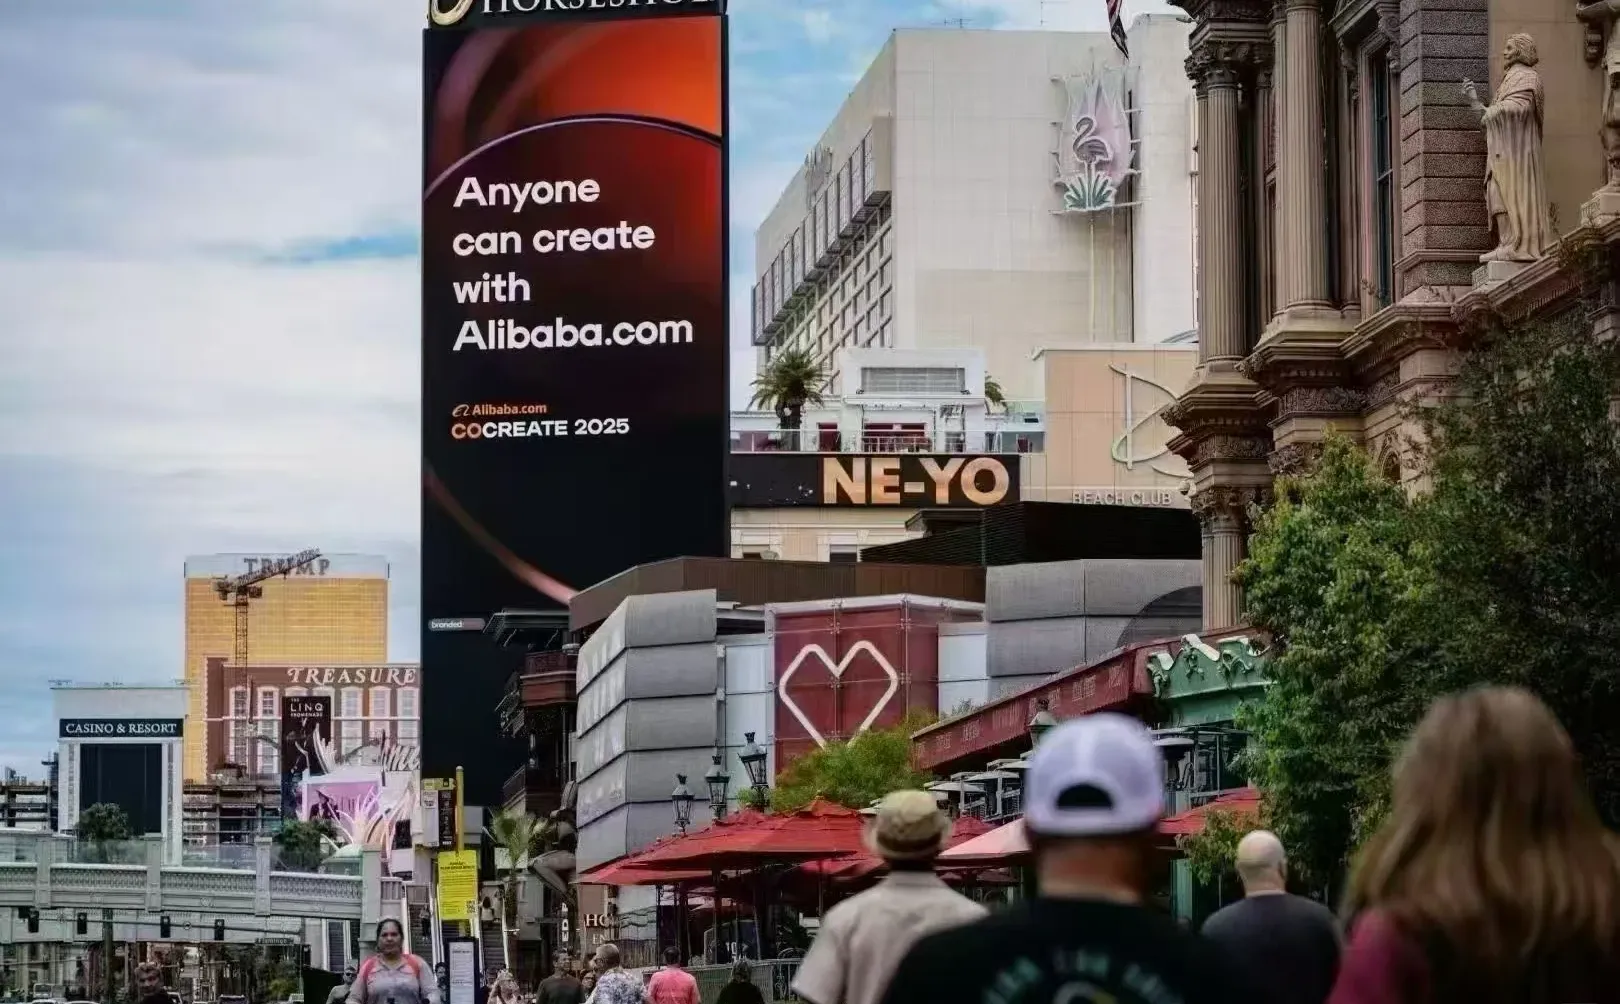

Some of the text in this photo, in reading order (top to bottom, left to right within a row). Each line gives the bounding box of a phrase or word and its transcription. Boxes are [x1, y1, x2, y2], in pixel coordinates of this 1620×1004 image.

[453, 176, 601, 213] Anyone
[453, 220, 656, 257] can create
[453, 271, 531, 304] with
[452, 317, 694, 351] Alibaba.com
[472, 404, 547, 416] Alibaba.com
[451, 418, 630, 439] COCREATE 2025
[823, 457, 1010, 505] NE-YO
[1072, 490, 1172, 506] BEACH CLUB
[287, 667, 417, 686] TREASURE
[290, 703, 324, 712] LINQ
[65, 723, 177, 734] CASINO & RESORT
